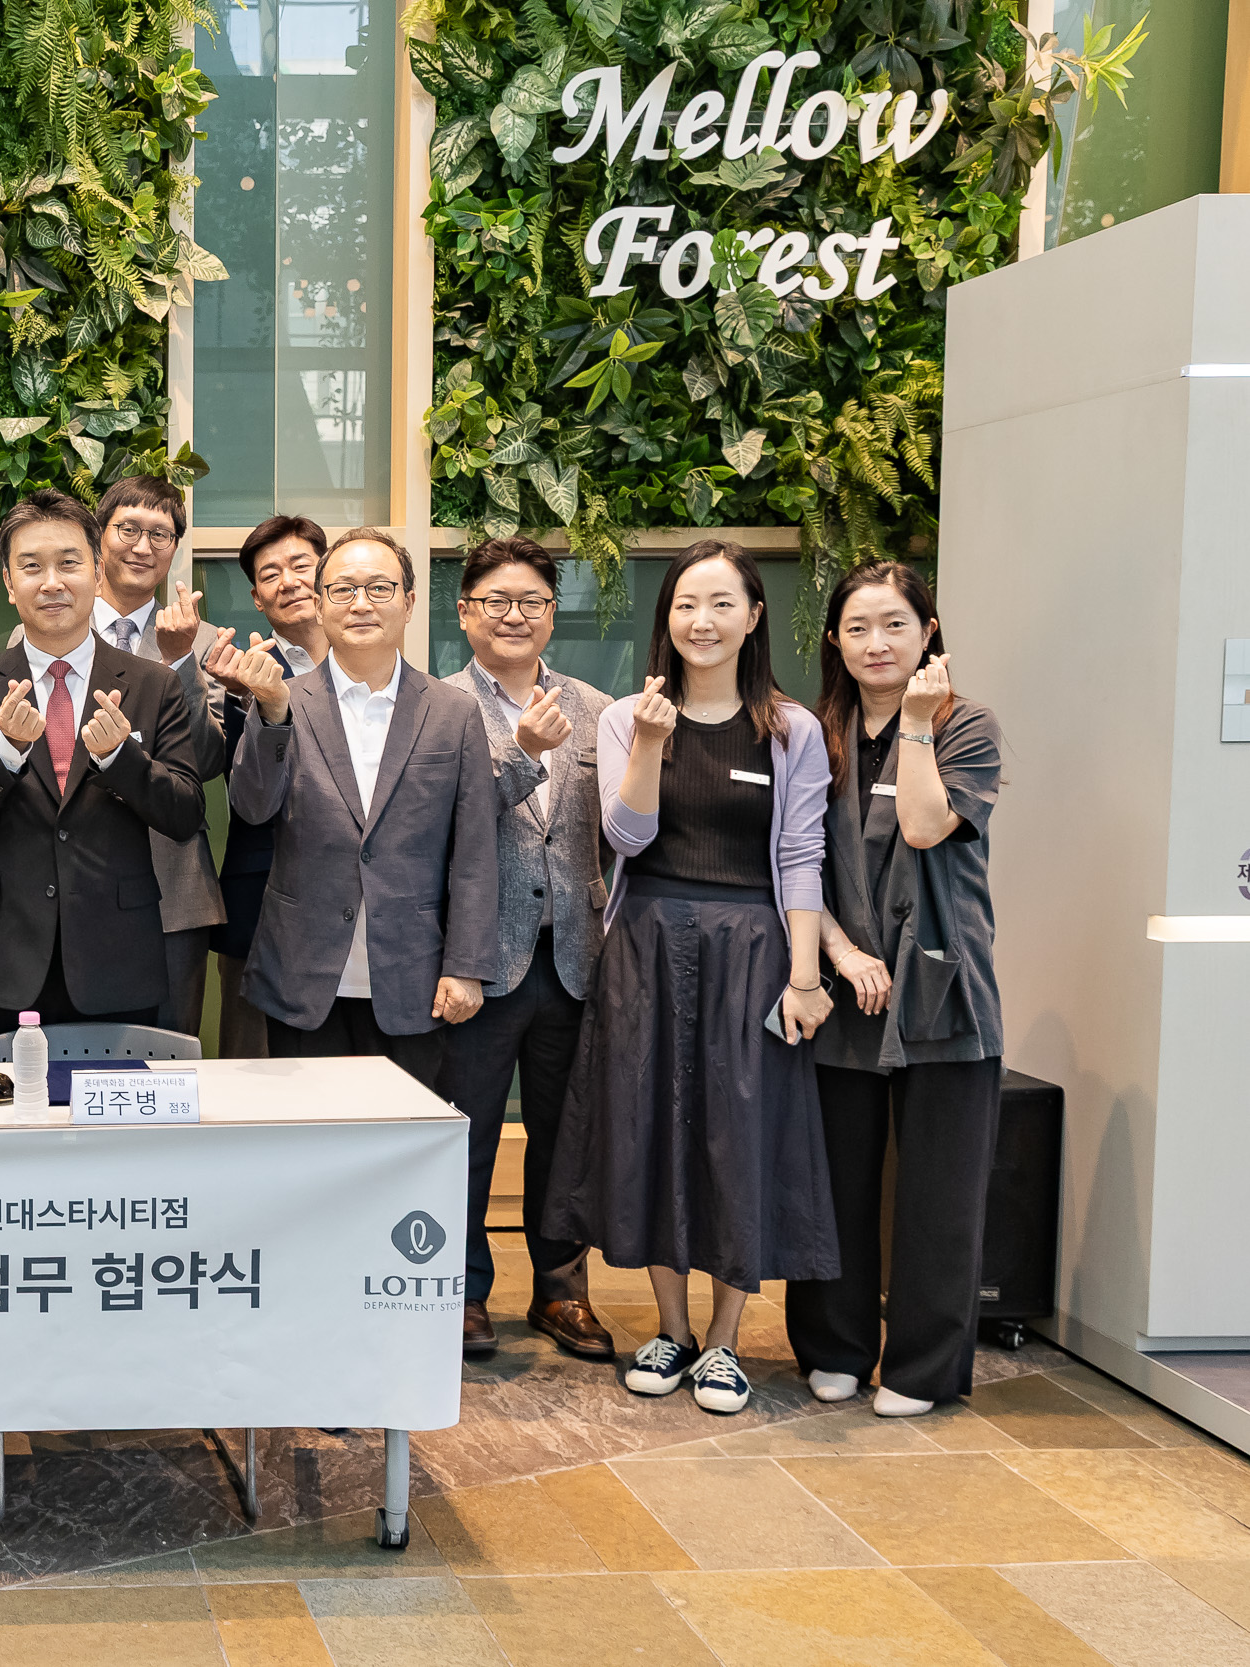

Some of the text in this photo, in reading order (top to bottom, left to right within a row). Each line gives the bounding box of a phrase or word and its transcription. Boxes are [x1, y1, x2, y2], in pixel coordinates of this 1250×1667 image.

[552, 50, 949, 167] Mellow
[83, 1077, 186, 1088] 롯데백화점 건대스타시티점
[83, 1090, 191, 1116] 김주병 점장
[91, 1248, 261, 1312] 협약식
[364, 1275, 464, 1297] LOTTE
[363, 1301, 436, 1312] DEPARTMENT
